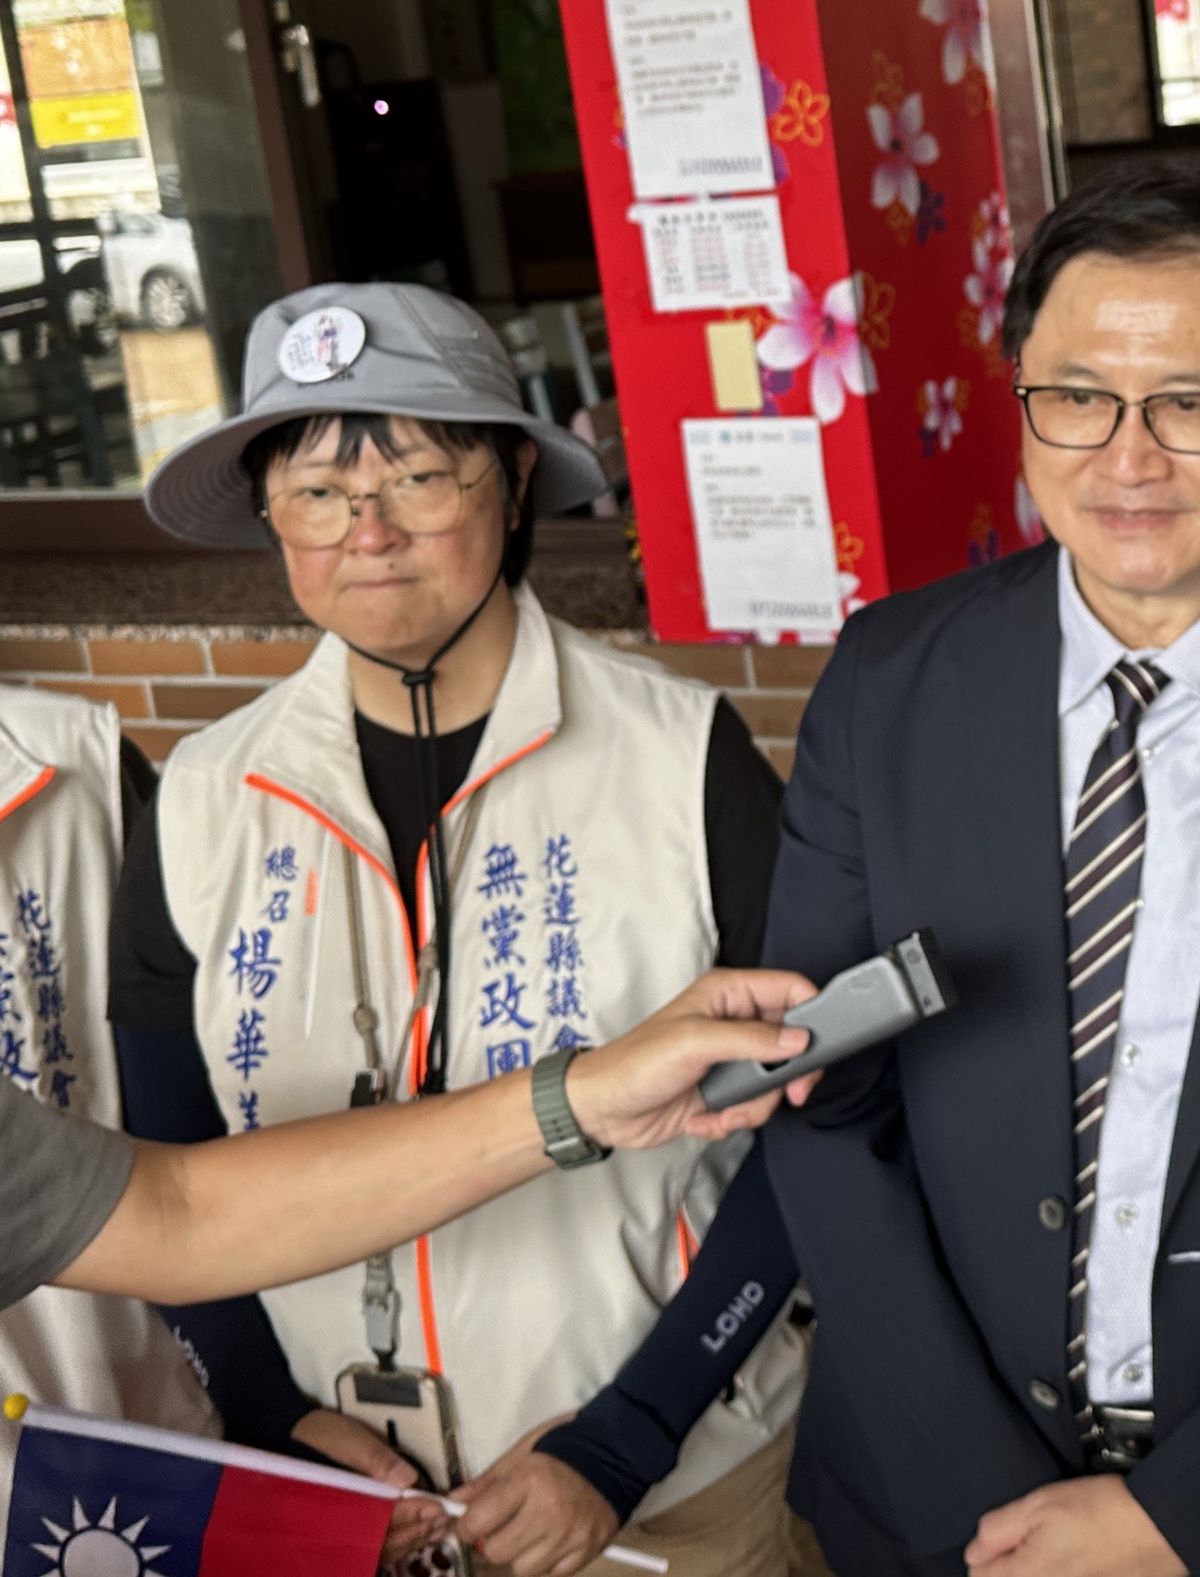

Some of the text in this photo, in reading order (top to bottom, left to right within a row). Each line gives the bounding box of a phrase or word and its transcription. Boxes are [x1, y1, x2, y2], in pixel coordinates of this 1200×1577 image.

[261, 843, 299, 923] 總召
[477, 841, 537, 1080] 無黨政團
